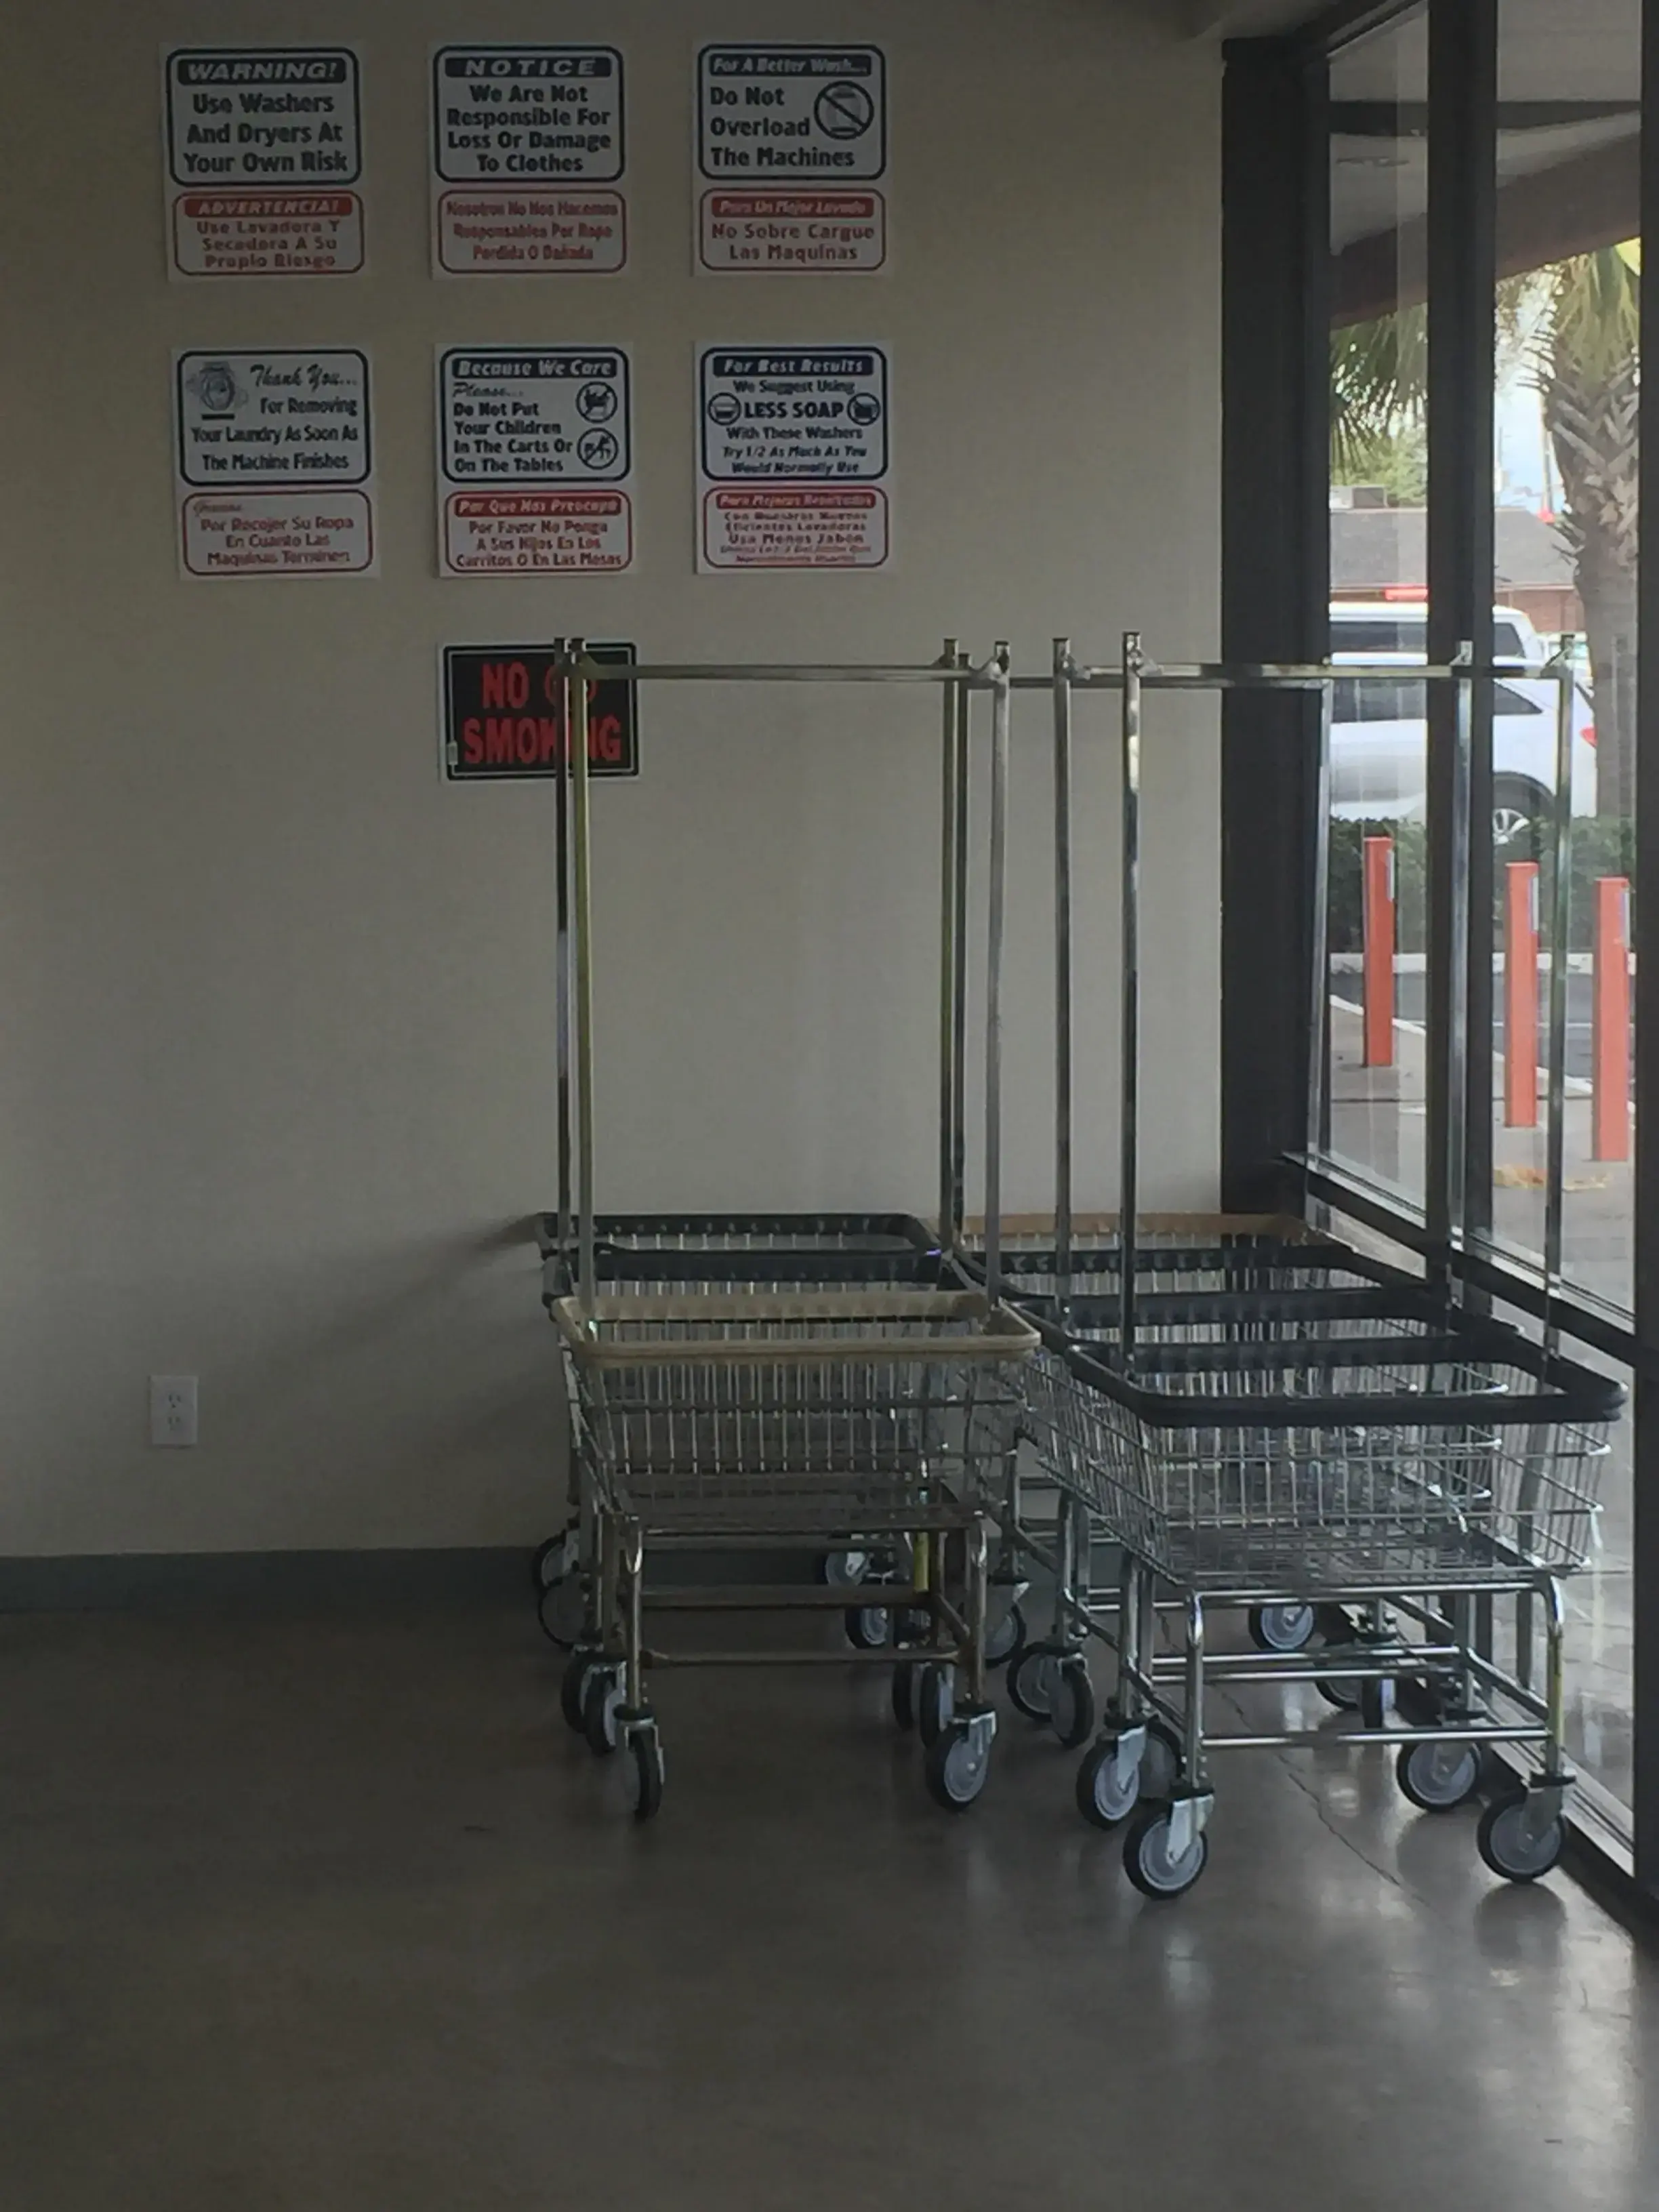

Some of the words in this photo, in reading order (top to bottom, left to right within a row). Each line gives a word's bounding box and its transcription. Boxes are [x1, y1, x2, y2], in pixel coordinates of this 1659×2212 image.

[187, 62, 337, 81] WARNING!
[464, 60, 596, 75] NOTICE
[714, 60, 739, 72] For
[741, 60, 753, 72] A
[758, 60, 805, 72] Better
[470, 85, 502, 102] We
[509, 85, 544, 102] Are
[551, 85, 589, 102] Not
[711, 87, 737, 105] Do
[745, 87, 785, 106] Not
[192, 94, 232, 114] Use
[239, 93, 335, 113] Washers
[447, 108, 571, 129] Responsible
[577, 108, 611, 125] For
[711, 118, 810, 136] Overload
[187, 123, 230, 144] And
[238, 123, 312, 148] Dryers
[319, 122, 343, 142] At
[448, 132, 491, 148] Loss
[497, 132, 523, 148] Or
[529, 132, 611, 152] Damage
[183, 153, 235, 173] Your
[243, 152, 294, 172] Own
[301, 150, 348, 171] Risk
[477, 155, 499, 171] To
[506, 154, 583, 171] Clothes
[712, 148, 750, 166] The
[757, 147, 855, 167] Machines
[197, 221, 230, 234] Use
[237, 220, 322, 234] Lavadora
[330, 220, 340, 232] Y
[712, 224, 737, 239] No
[745, 224, 800, 238] Sobre
[808, 224, 874, 242] Cargue
[203, 238, 288, 251] Secadora
[295, 237, 307, 250] A
[316, 237, 337, 249] Su
[730, 245, 760, 260] Las
[458, 361, 531, 375] Because
[539, 360, 565, 375] We
[571, 360, 611, 375] Care
[724, 359, 752, 373] For
[758, 359, 795, 372] Best
[800, 359, 863, 372] Results
[251, 365, 303, 387] Thank
[733, 380, 755, 393] We
[760, 380, 813, 395] Suggest
[817, 380, 855, 394] Using
[261, 398, 284, 414] For
[289, 396, 358, 416] Removing
[454, 403, 474, 416] Do
[479, 403, 507, 416] Not
[512, 403, 539, 416] Put
[745, 403, 787, 418] LESS
[793, 402, 844, 418] SOAP
[191, 427, 221, 442] Your
[226, 427, 281, 445] Laundry
[285, 426, 301, 441] As
[304, 425, 338, 441] Soon
[342, 425, 359, 440] As
[455, 422, 489, 436] Your
[495, 420, 561, 435] Children
[726, 427, 760, 439] With
[763, 427, 802, 439] These
[806, 427, 863, 439] Washers
[455, 440, 470, 453] In
[475, 439, 502, 453] The
[508, 439, 549, 453] Carts
[554, 439, 573, 453] Or
[723, 446, 742, 458] Try
[746, 446, 765, 457] 1/2
[770, 446, 785, 457] As
[788, 446, 821, 457] Much
[825, 446, 840, 457] As
[845, 446, 867, 457] You
[203, 455, 227, 470] The
[232, 455, 289, 470] Machine
[294, 452, 349, 469] Finishes
[455, 458, 476, 473] On
[481, 458, 509, 472] The
[514, 458, 563, 472] Tables
[732, 462, 771, 473] Would
[773, 462, 833, 474] Normally
[837, 462, 859, 472] Use
[292, 516, 310, 529] Su
[469, 521, 493, 534] Por
[498, 521, 537, 534] Favor
[541, 520, 559, 533] No
[226, 535, 243, 547] En
[476, 538, 487, 551] A
[517, 554, 527, 566] O
[554, 554, 575, 565] Las
[483, 661, 529, 708] NO
